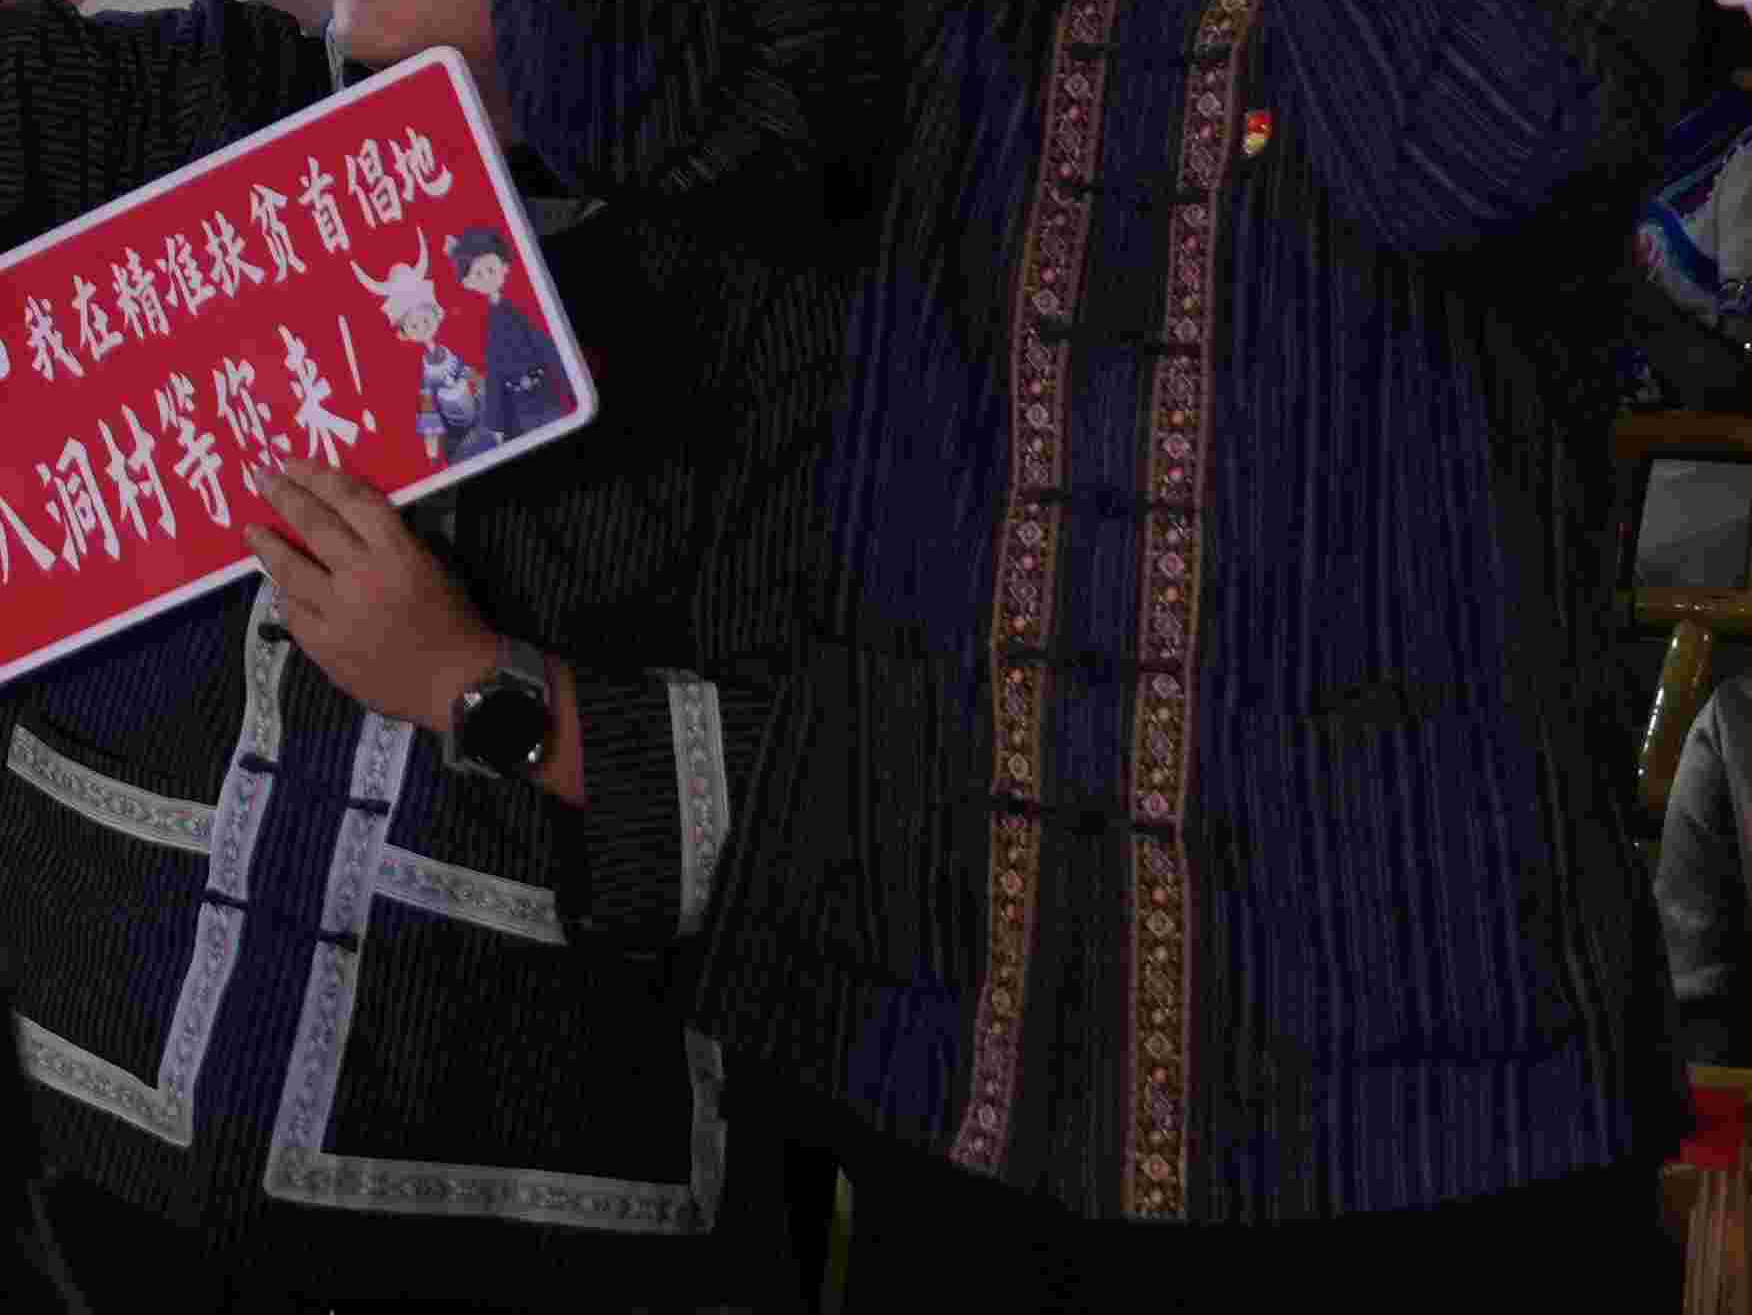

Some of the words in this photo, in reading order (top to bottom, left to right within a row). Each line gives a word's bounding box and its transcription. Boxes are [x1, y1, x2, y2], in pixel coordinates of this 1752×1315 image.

[22, 126, 453, 383] 我在精准扶贫首倡地
